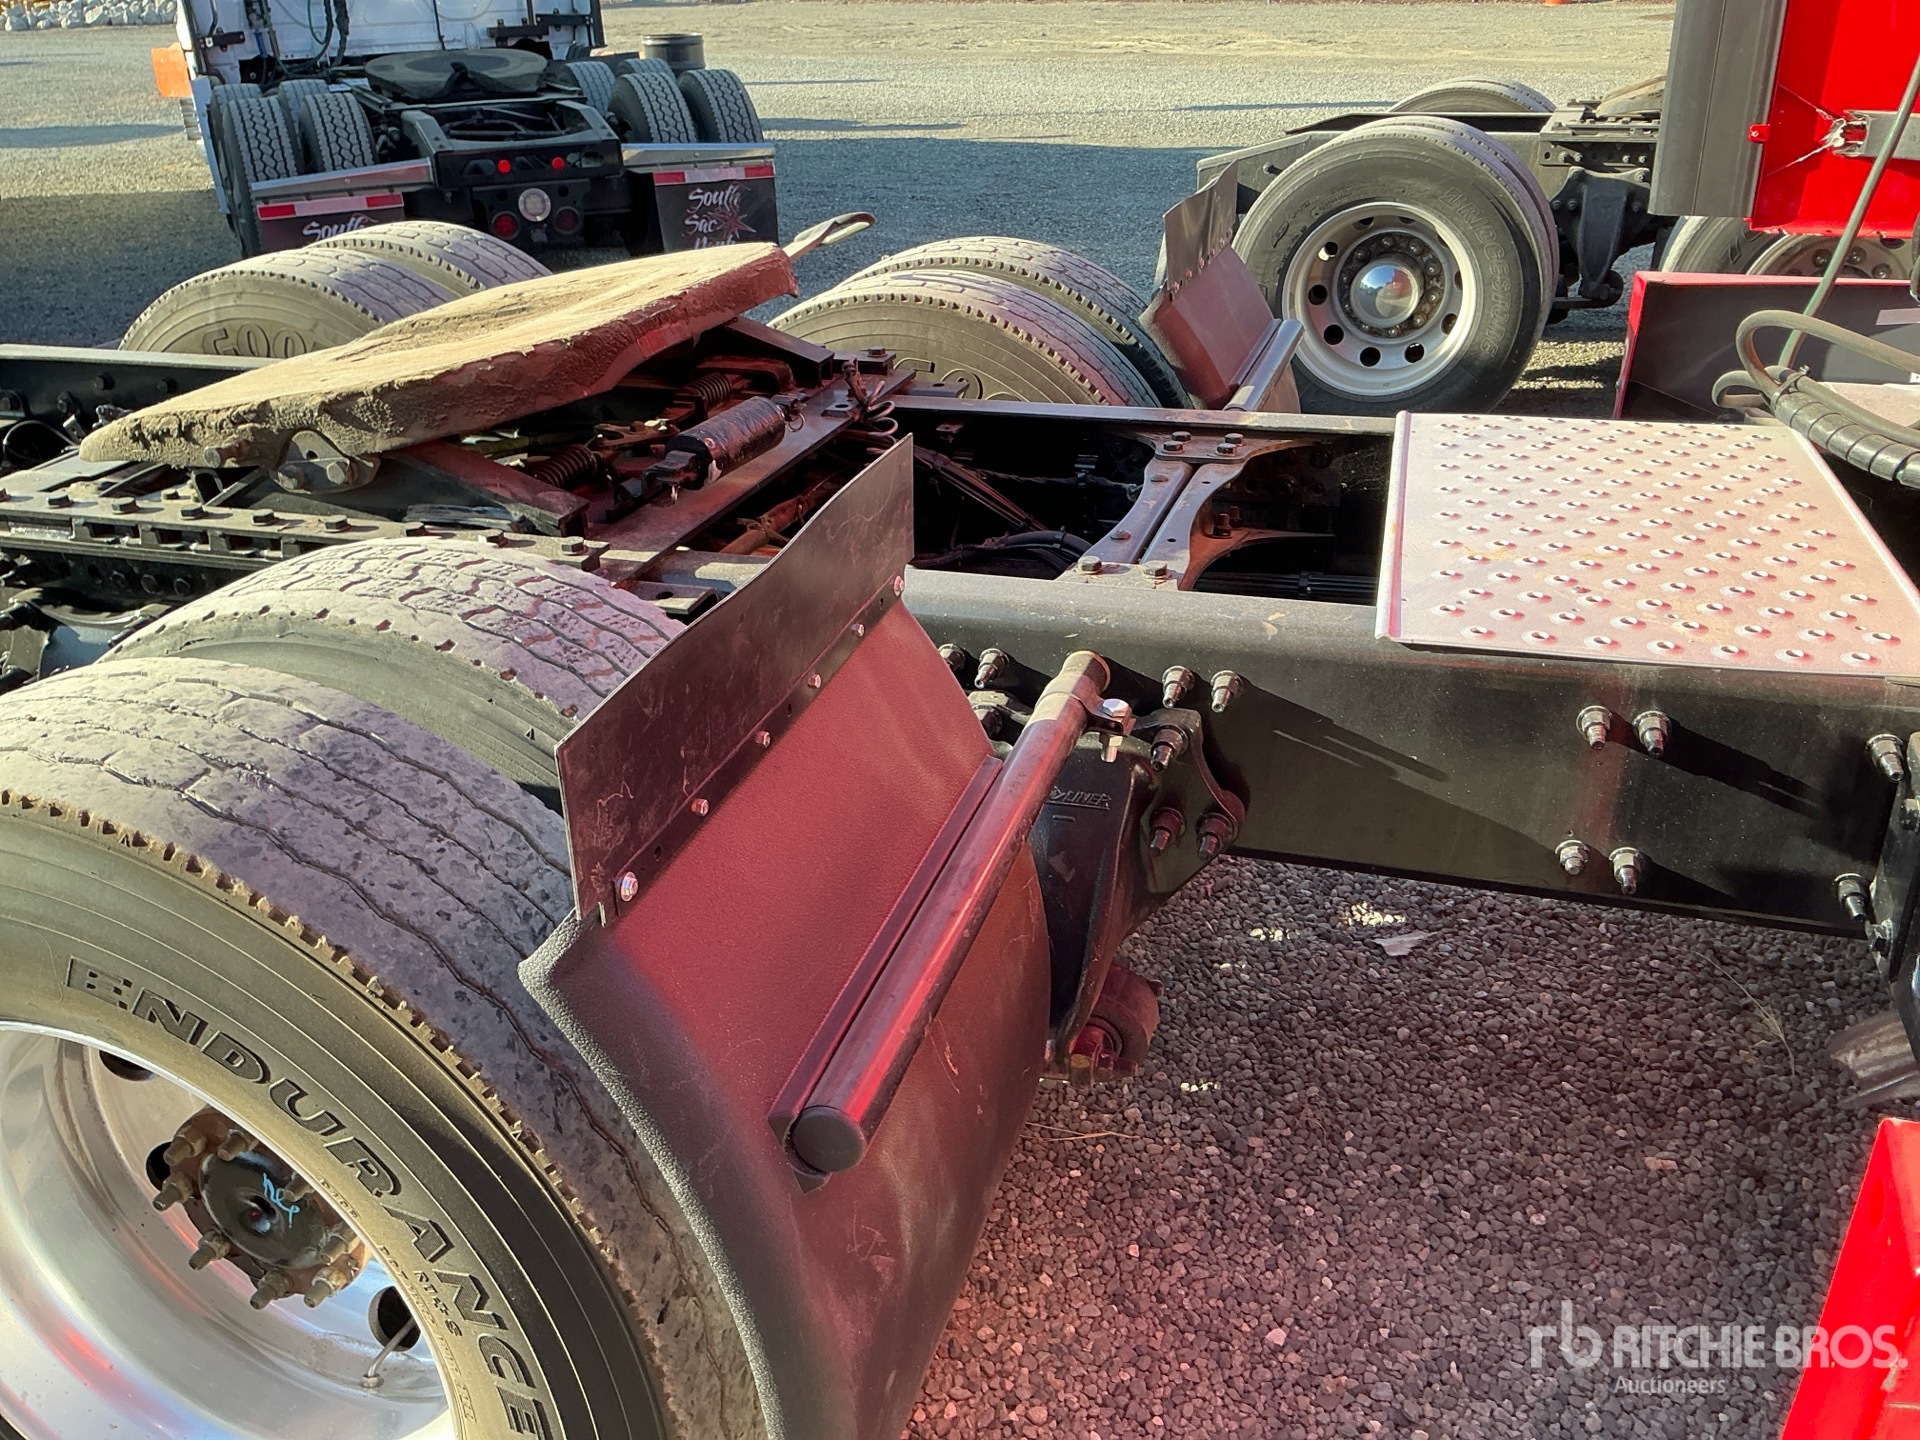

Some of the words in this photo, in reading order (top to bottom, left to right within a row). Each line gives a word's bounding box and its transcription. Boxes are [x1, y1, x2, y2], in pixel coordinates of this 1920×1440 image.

[682, 213, 718, 237] Sac
[1438, 188, 1512, 359] BRIDGESTONE
[65, 955, 548, 1440] ENDURANCE
